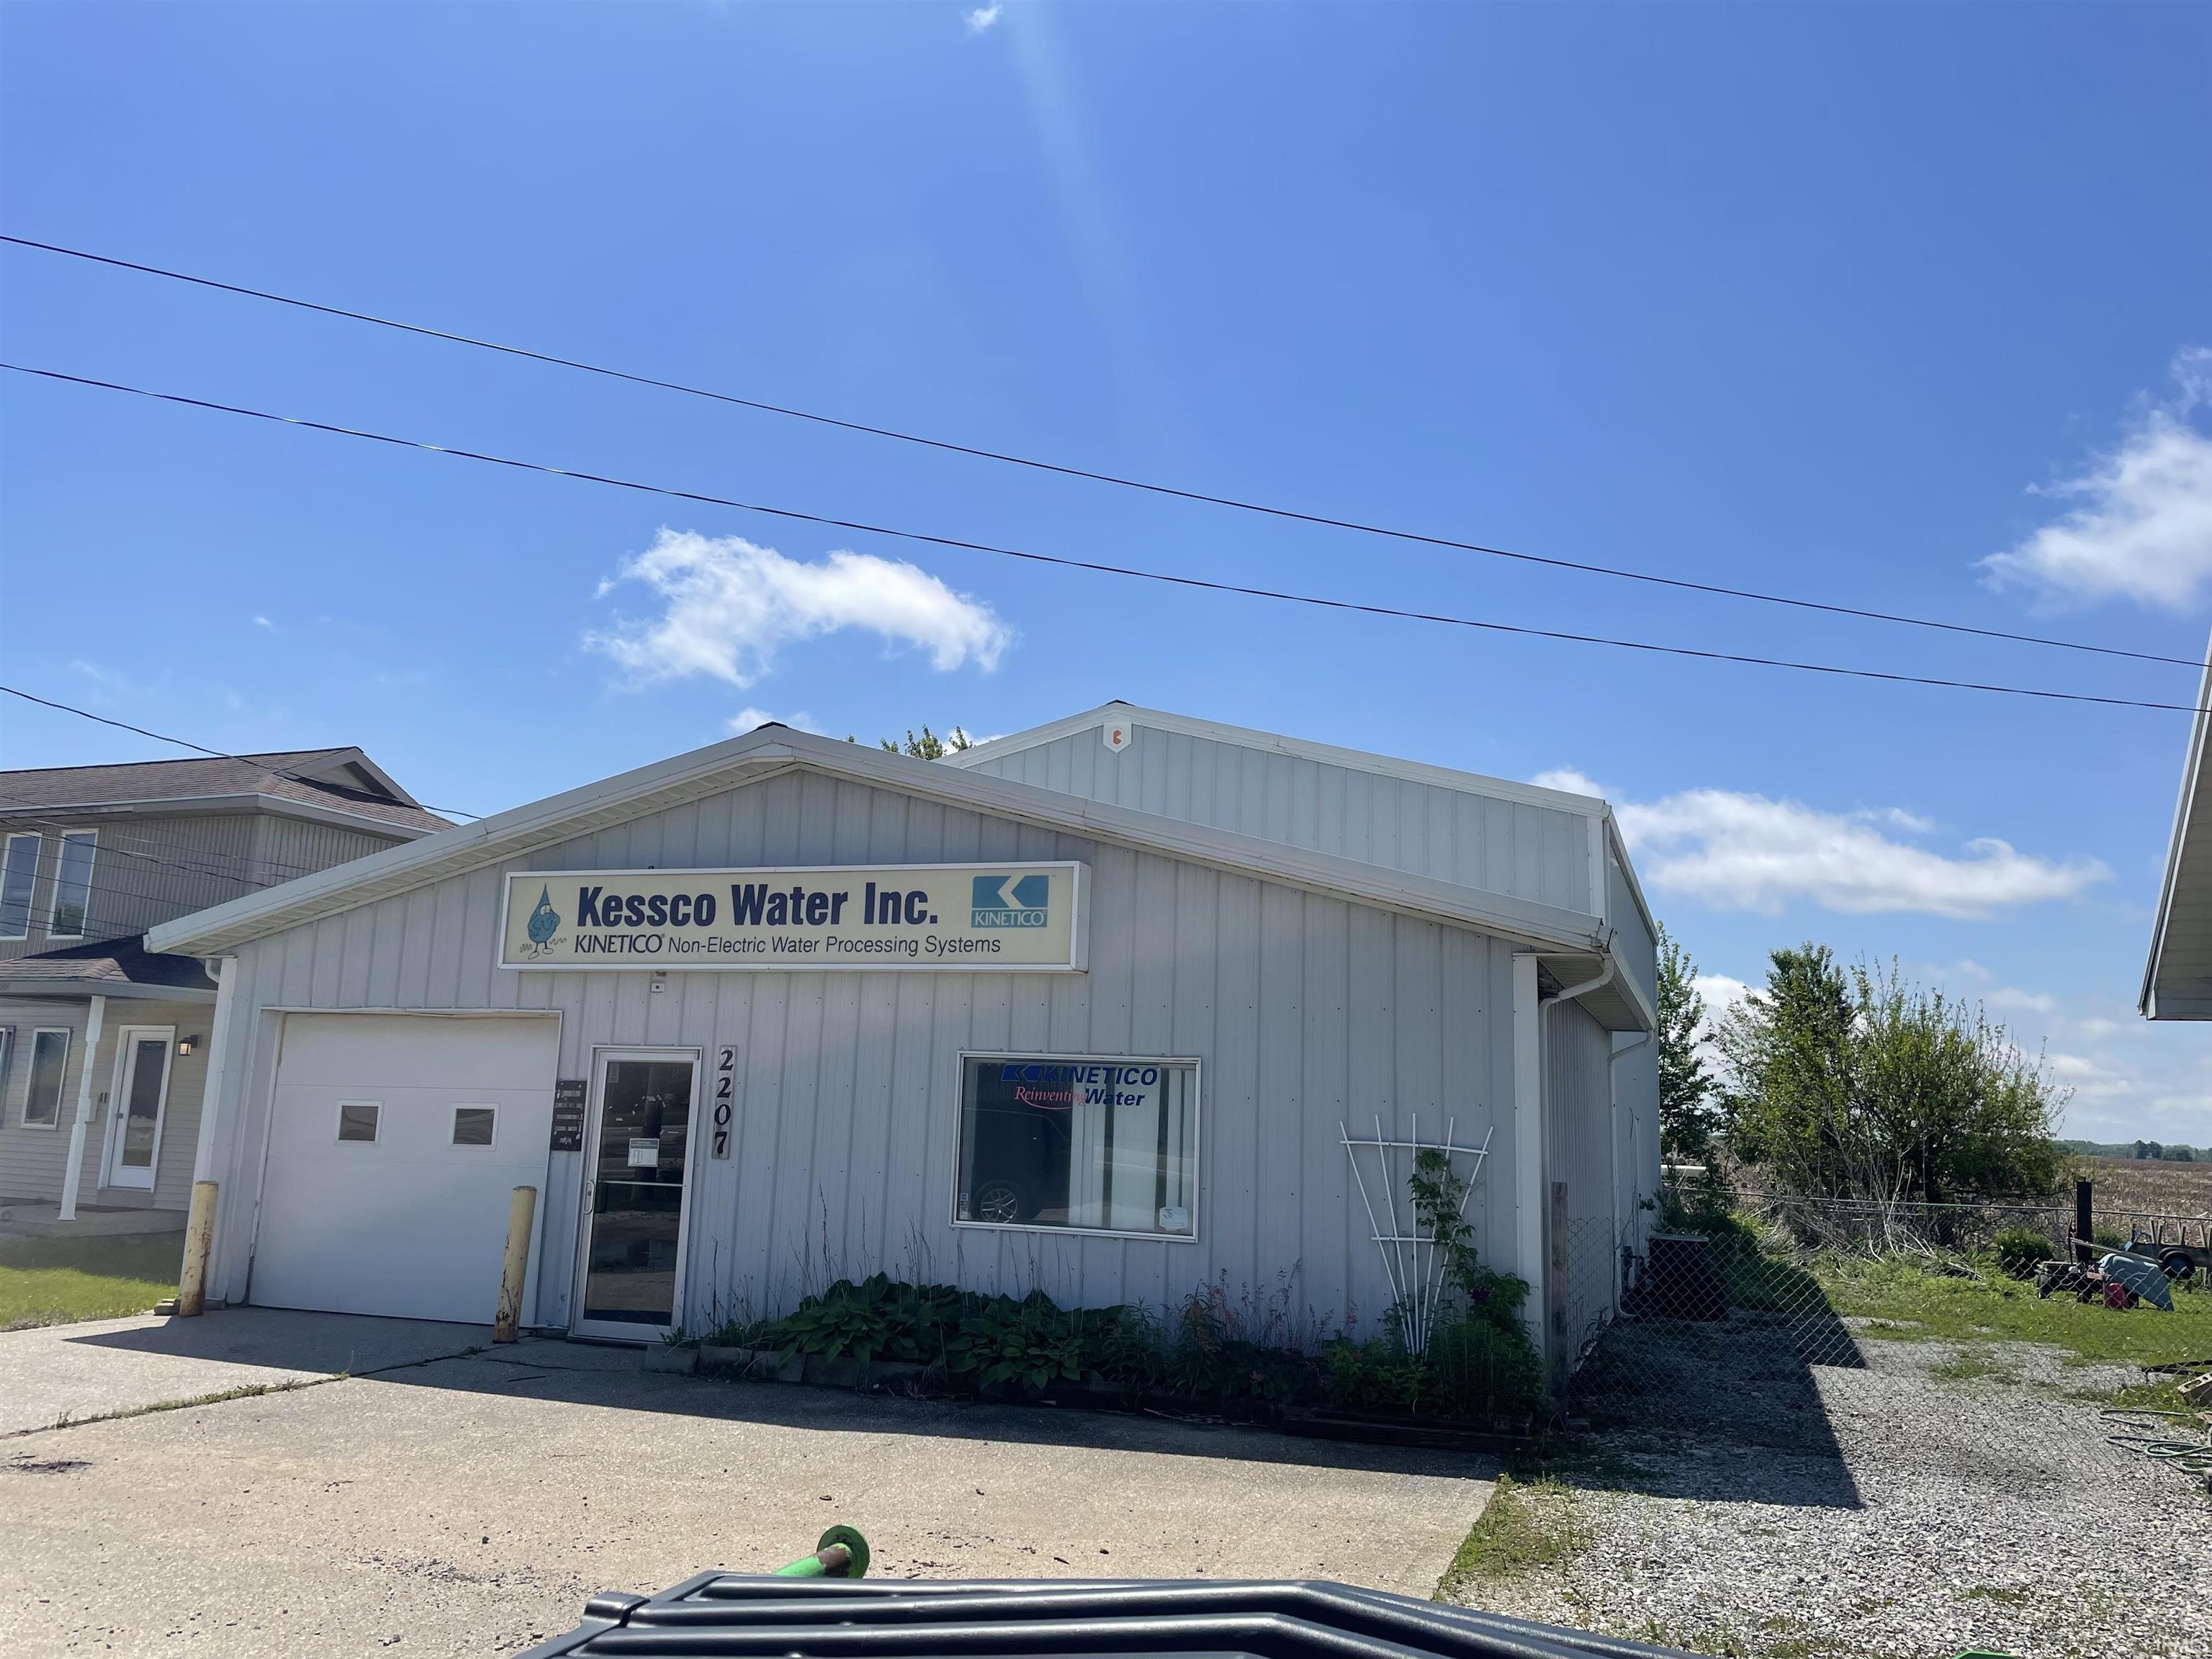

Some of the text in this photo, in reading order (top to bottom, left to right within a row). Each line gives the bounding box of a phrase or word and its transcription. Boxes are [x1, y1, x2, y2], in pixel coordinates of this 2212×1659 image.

[577, 882, 938, 927] Kessco Water Inc.
[974, 911, 1044, 926] KINETICO
[668, 937, 765, 953] Non-Electric
[772, 937, 819, 953] Water
[825, 935, 919, 957] Processing
[925, 935, 1001, 957] Systems
[714, 1049, 733, 1154] 2207
[1014, 1086, 1145, 1107] Reinventing Water
